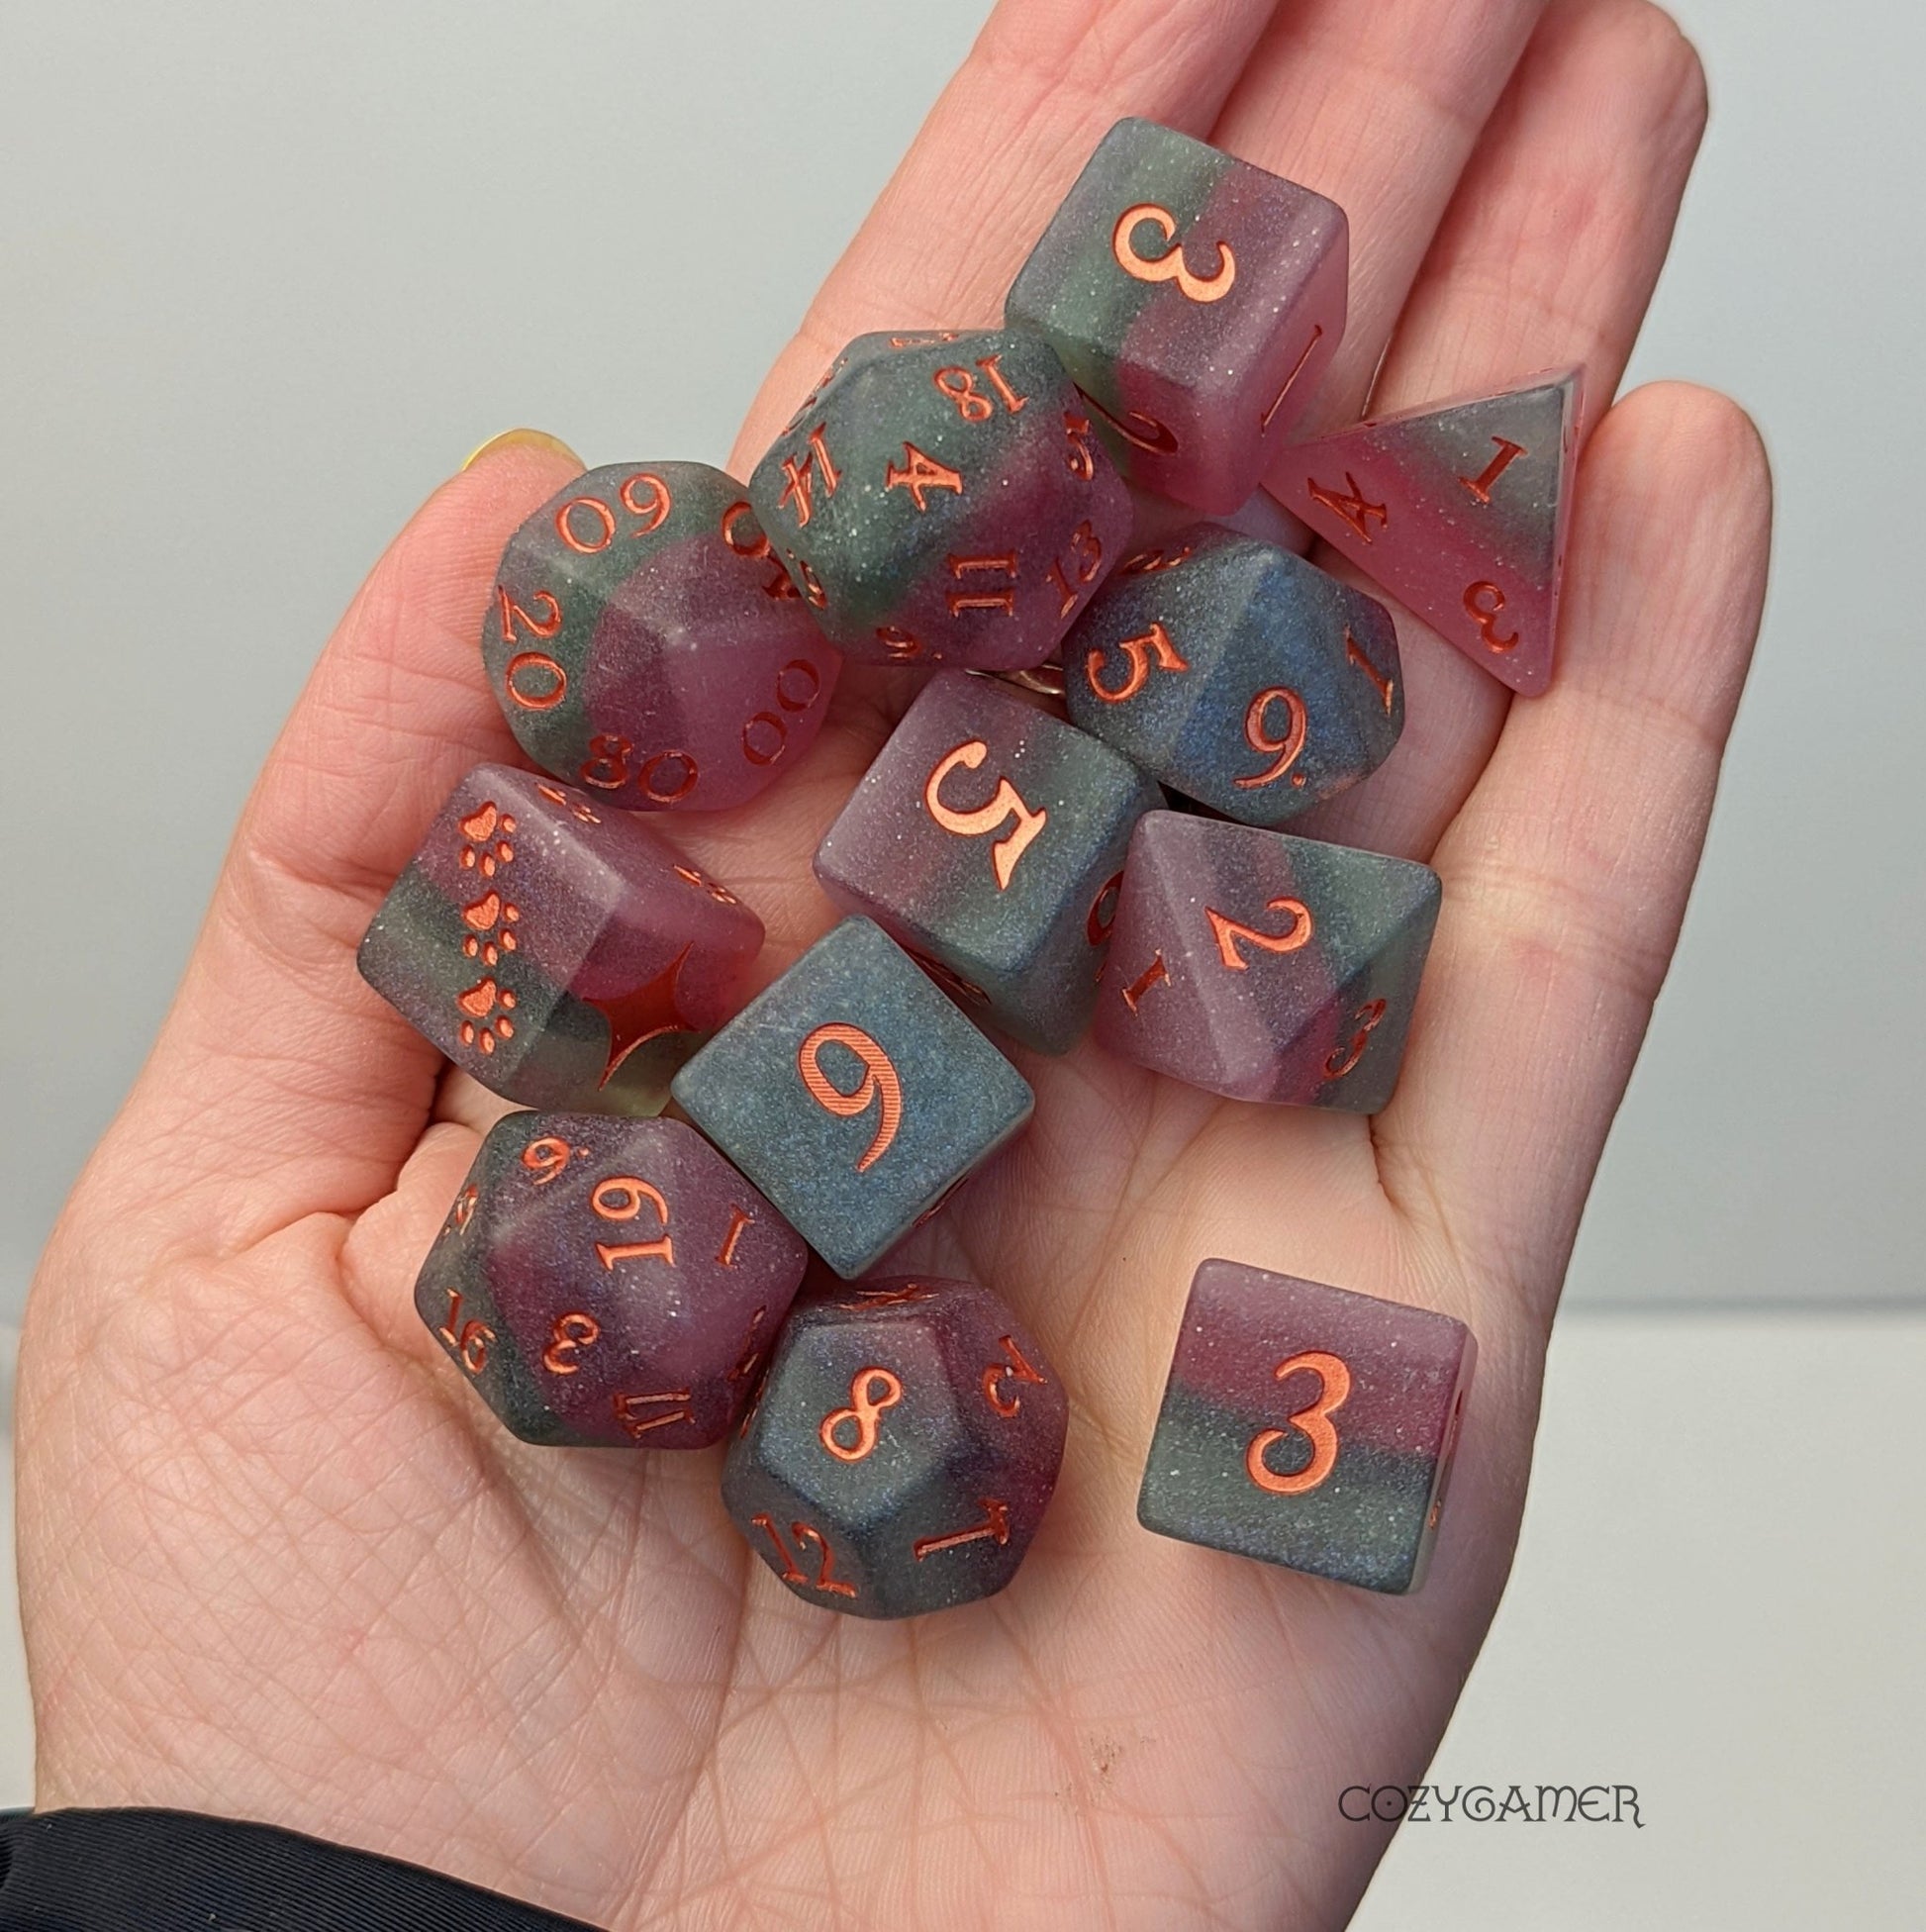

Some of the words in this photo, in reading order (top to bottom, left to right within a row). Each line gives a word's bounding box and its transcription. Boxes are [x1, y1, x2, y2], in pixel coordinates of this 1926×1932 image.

[1112, 202, 1237, 303] 3
[933, 353, 1029, 424] 18
[778, 421, 841, 529] 14
[886, 440, 965, 514] 4
[1307, 471, 1389, 546] 4
[1458, 435, 1528, 507] 1
[945, 547, 1018, 618] 11
[1044, 519, 1104, 621] 13
[498, 584, 568, 711] 20
[1462, 580, 1521, 654] 3
[1085, 621, 1190, 706] 5
[741, 658, 821, 767] 00
[579, 732, 699, 804] 80
[924, 740, 1048, 892] 5
[1204, 895, 1314, 972] 2
[1119, 947, 1173, 1016] 1
[1320, 998, 1388, 1080] 3
[590, 1175, 677, 1272] 19
[715, 1201, 758, 1269] 1
[438, 1287, 497, 1375] 16
[541, 1309, 599, 1375] 3
[819, 1365, 903, 1464] 8
[1245, 1349, 1353, 1497] 3
[750, 1512, 857, 1600] 12
